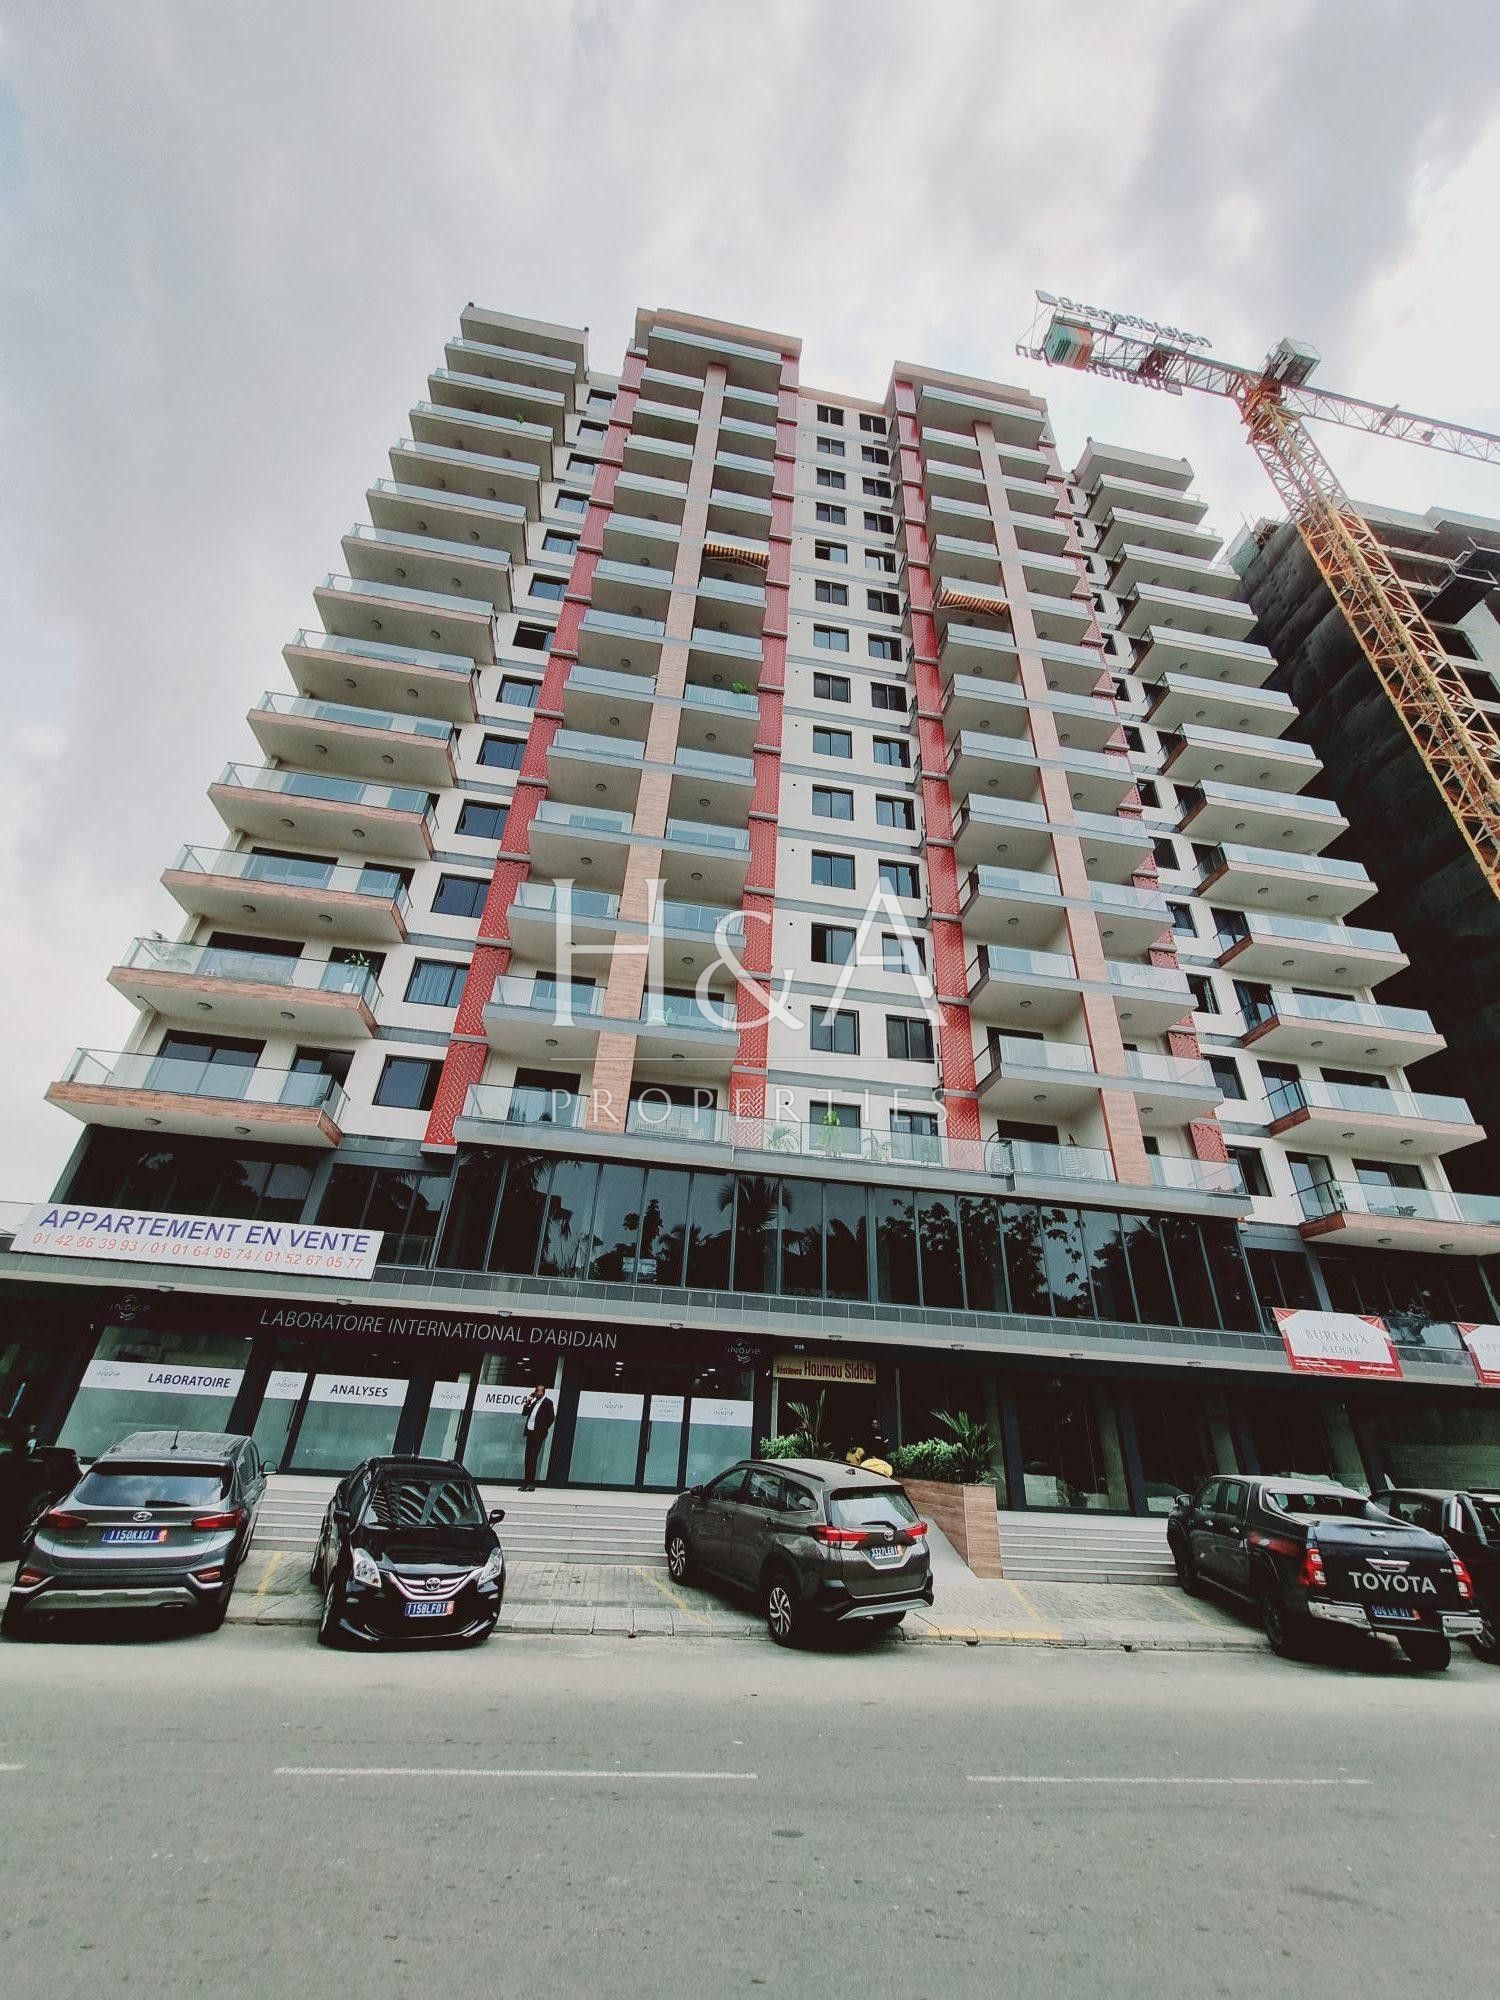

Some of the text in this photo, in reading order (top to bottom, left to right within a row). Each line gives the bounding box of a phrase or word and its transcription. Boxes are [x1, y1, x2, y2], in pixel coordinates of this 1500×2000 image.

[39, 1209, 371, 1253] APPARTEMENT EN VENTE
[32, 1232, 50, 1245] 01
[55, 1234, 74, 1247] 42
[98, 1238, 117, 1250] 39
[120, 1239, 139, 1251] 93
[150, 1242, 168, 1254] 01
[172, 1243, 189, 1255] 01
[193, 1245, 211, 1257] 64
[264, 1251, 281, 1263] 01
[285, 1253, 302, 1265] 52
[306, 1254, 323, 1266] 67
[326, 1256, 343, 1268] 05
[348, 1258, 364, 1269] 77
[260, 1309, 618, 1350] LABORATOIRE INTERNATIONAL D'ABIDJAN
[1304, 1328, 1370, 1344] BUREAUX
[804, 1360, 842, 1379] Houmou
[844, 1363, 874, 1380] Sidibé
[148, 1373, 232, 1388] LABORATOIRE
[330, 1384, 389, 1397] ANALYSES
[485, 1393, 528, 1405] MEDICA
[1348, 1571, 1437, 1594] TOYOTA
